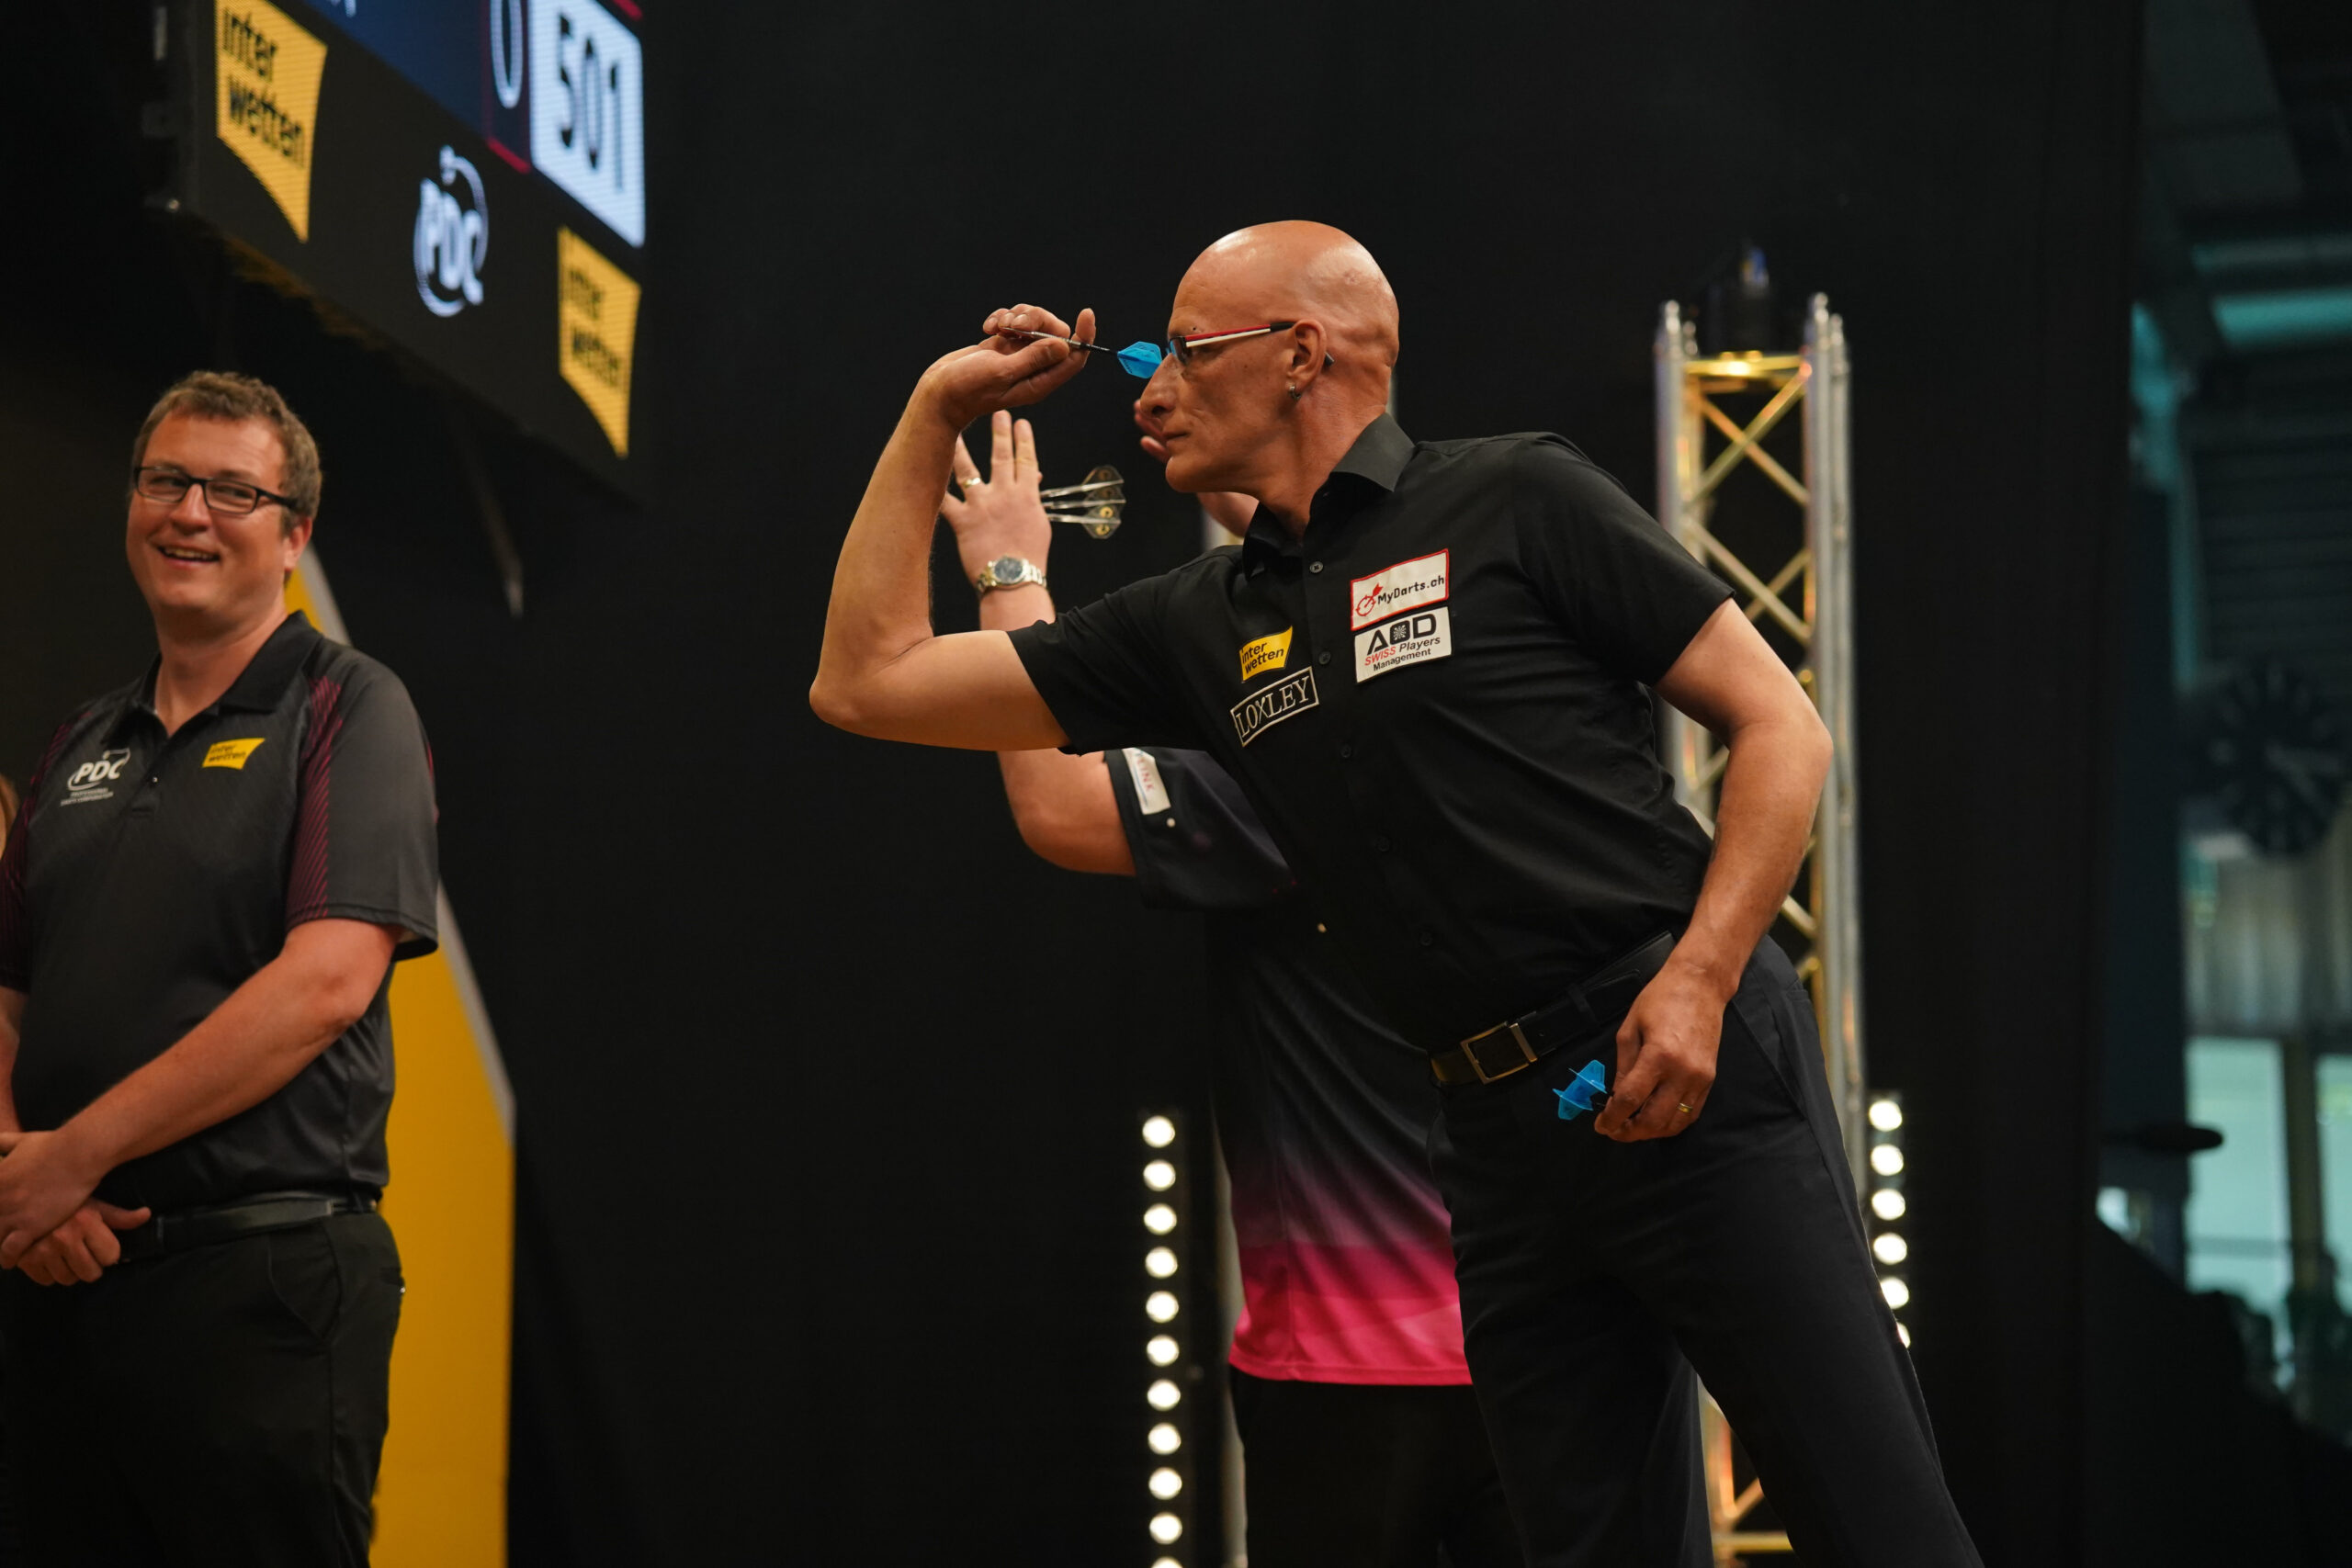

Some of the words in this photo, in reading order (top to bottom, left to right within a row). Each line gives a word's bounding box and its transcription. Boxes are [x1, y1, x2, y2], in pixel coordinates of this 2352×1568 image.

[222, 7, 278, 84] inter
[560, 11, 627, 195] 501
[228, 73, 306, 169] wetten
[419, 176, 484, 306] PDC
[1377, 575, 1445, 605] MyDarts.ch
[1241, 642, 1268, 665] inter
[1244, 648, 1284, 675] wetten
[1364, 646, 1396, 666] SWISS
[1398, 637, 1442, 653] Players
[1373, 649, 1431, 671] Management
[1235, 675, 1310, 739] LOXLEY
[74, 759, 127, 784] PDC
